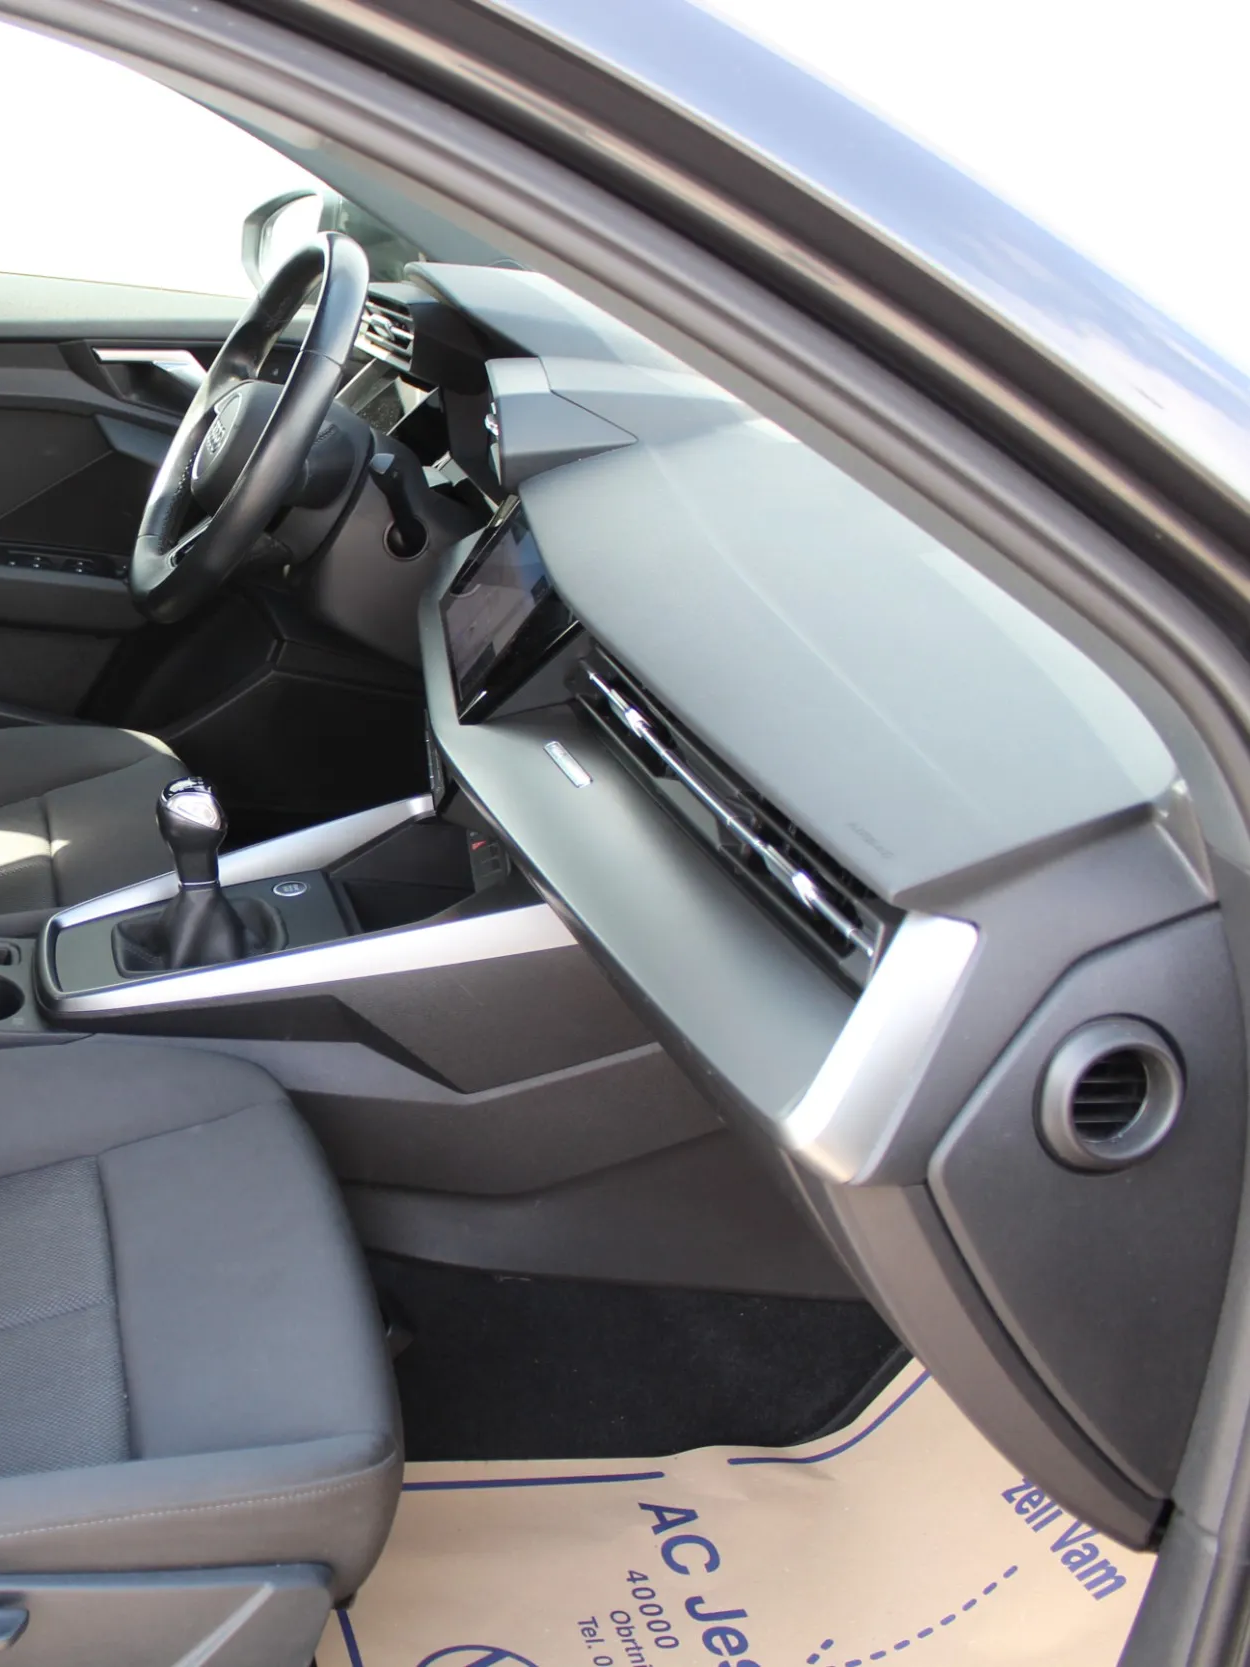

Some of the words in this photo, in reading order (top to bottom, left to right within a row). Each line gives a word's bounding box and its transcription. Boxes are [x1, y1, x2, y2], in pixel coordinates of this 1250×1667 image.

[637, 1502, 721, 1575] AC
[684, 1595, 761, 1667] Je
[1050, 1520, 1127, 1601] Vam
[577, 1616, 605, 1649] Tel.
[626, 1569, 680, 1649] 40000
